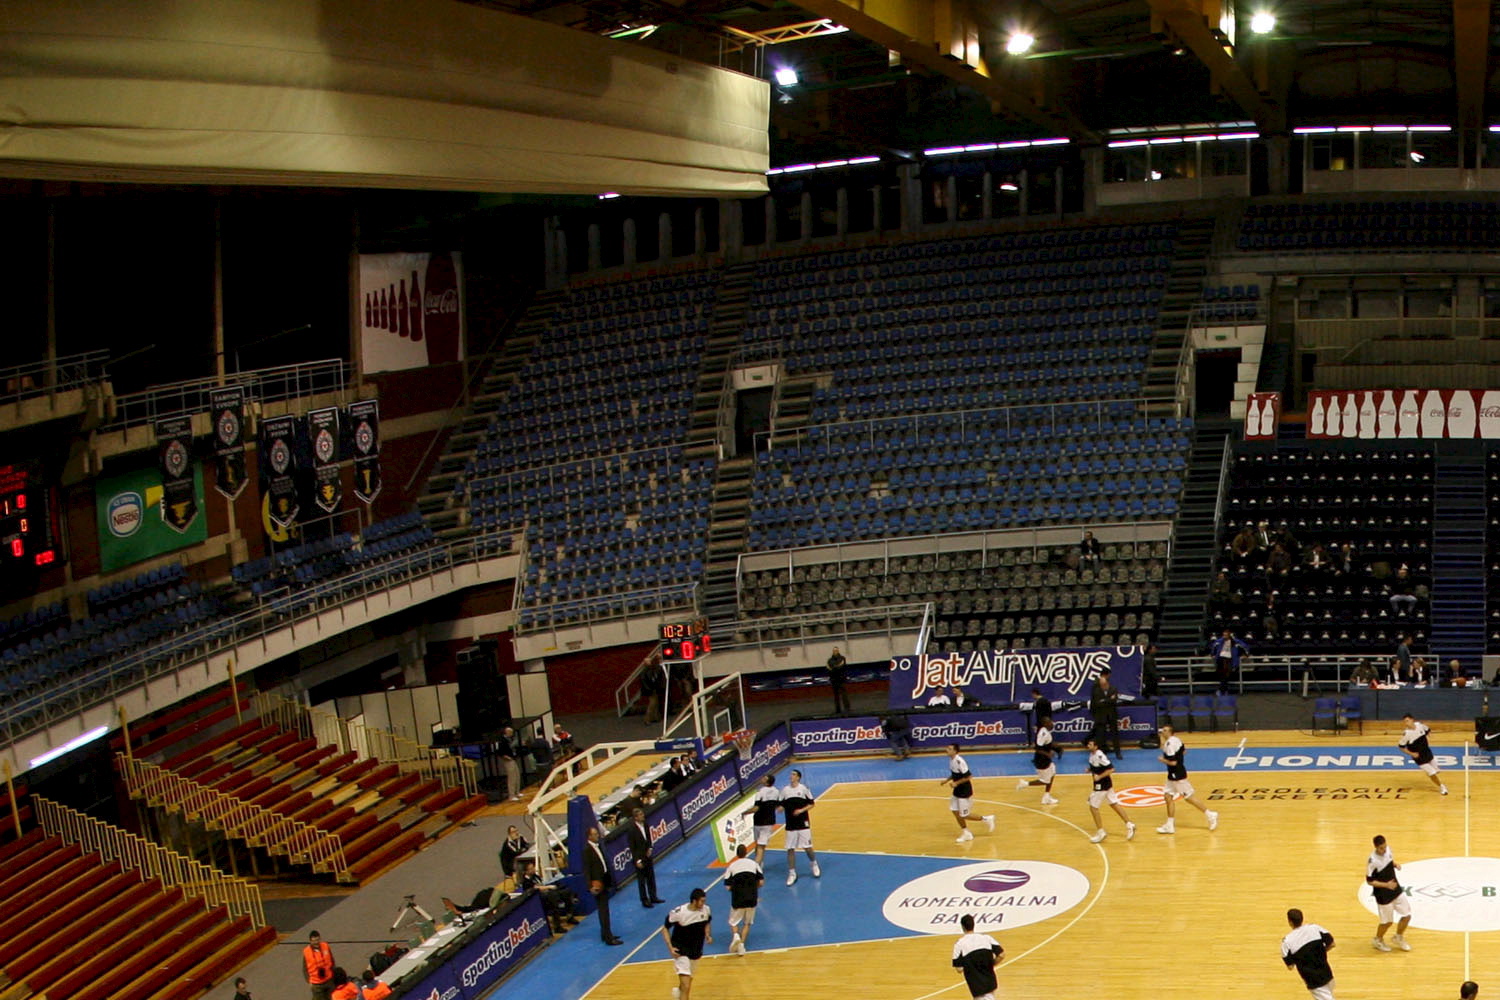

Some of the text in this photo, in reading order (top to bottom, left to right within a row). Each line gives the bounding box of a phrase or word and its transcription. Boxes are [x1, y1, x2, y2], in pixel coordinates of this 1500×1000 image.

[664, 624, 691, 638] 10:21
[911, 720, 1022, 740] sportingbet.com
[682, 774, 738, 821] sportingbet.com
[898, 896, 1058, 908] KOMERCIJALNA
[930, 913, 1004, 924] BAKA
[461, 918, 547, 988] sportingbet.com
